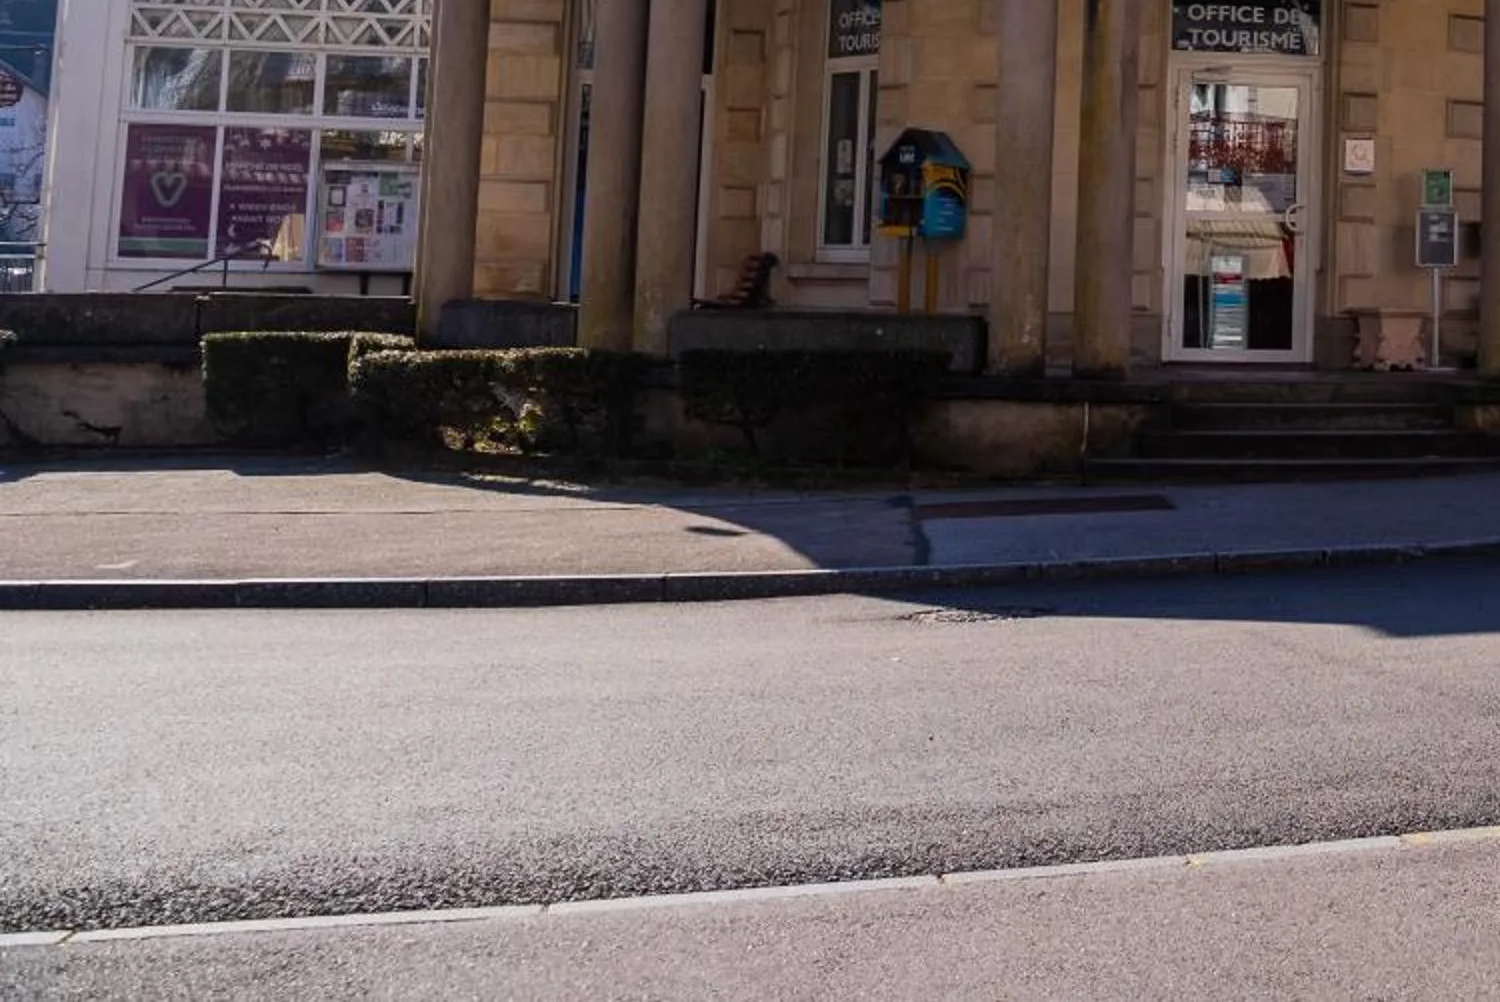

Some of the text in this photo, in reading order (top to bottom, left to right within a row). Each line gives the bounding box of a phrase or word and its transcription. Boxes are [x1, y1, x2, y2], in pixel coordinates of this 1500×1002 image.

[1187, 4, 1301, 25] OFFICE DE
[1187, 28, 1301, 50] TOURISME
